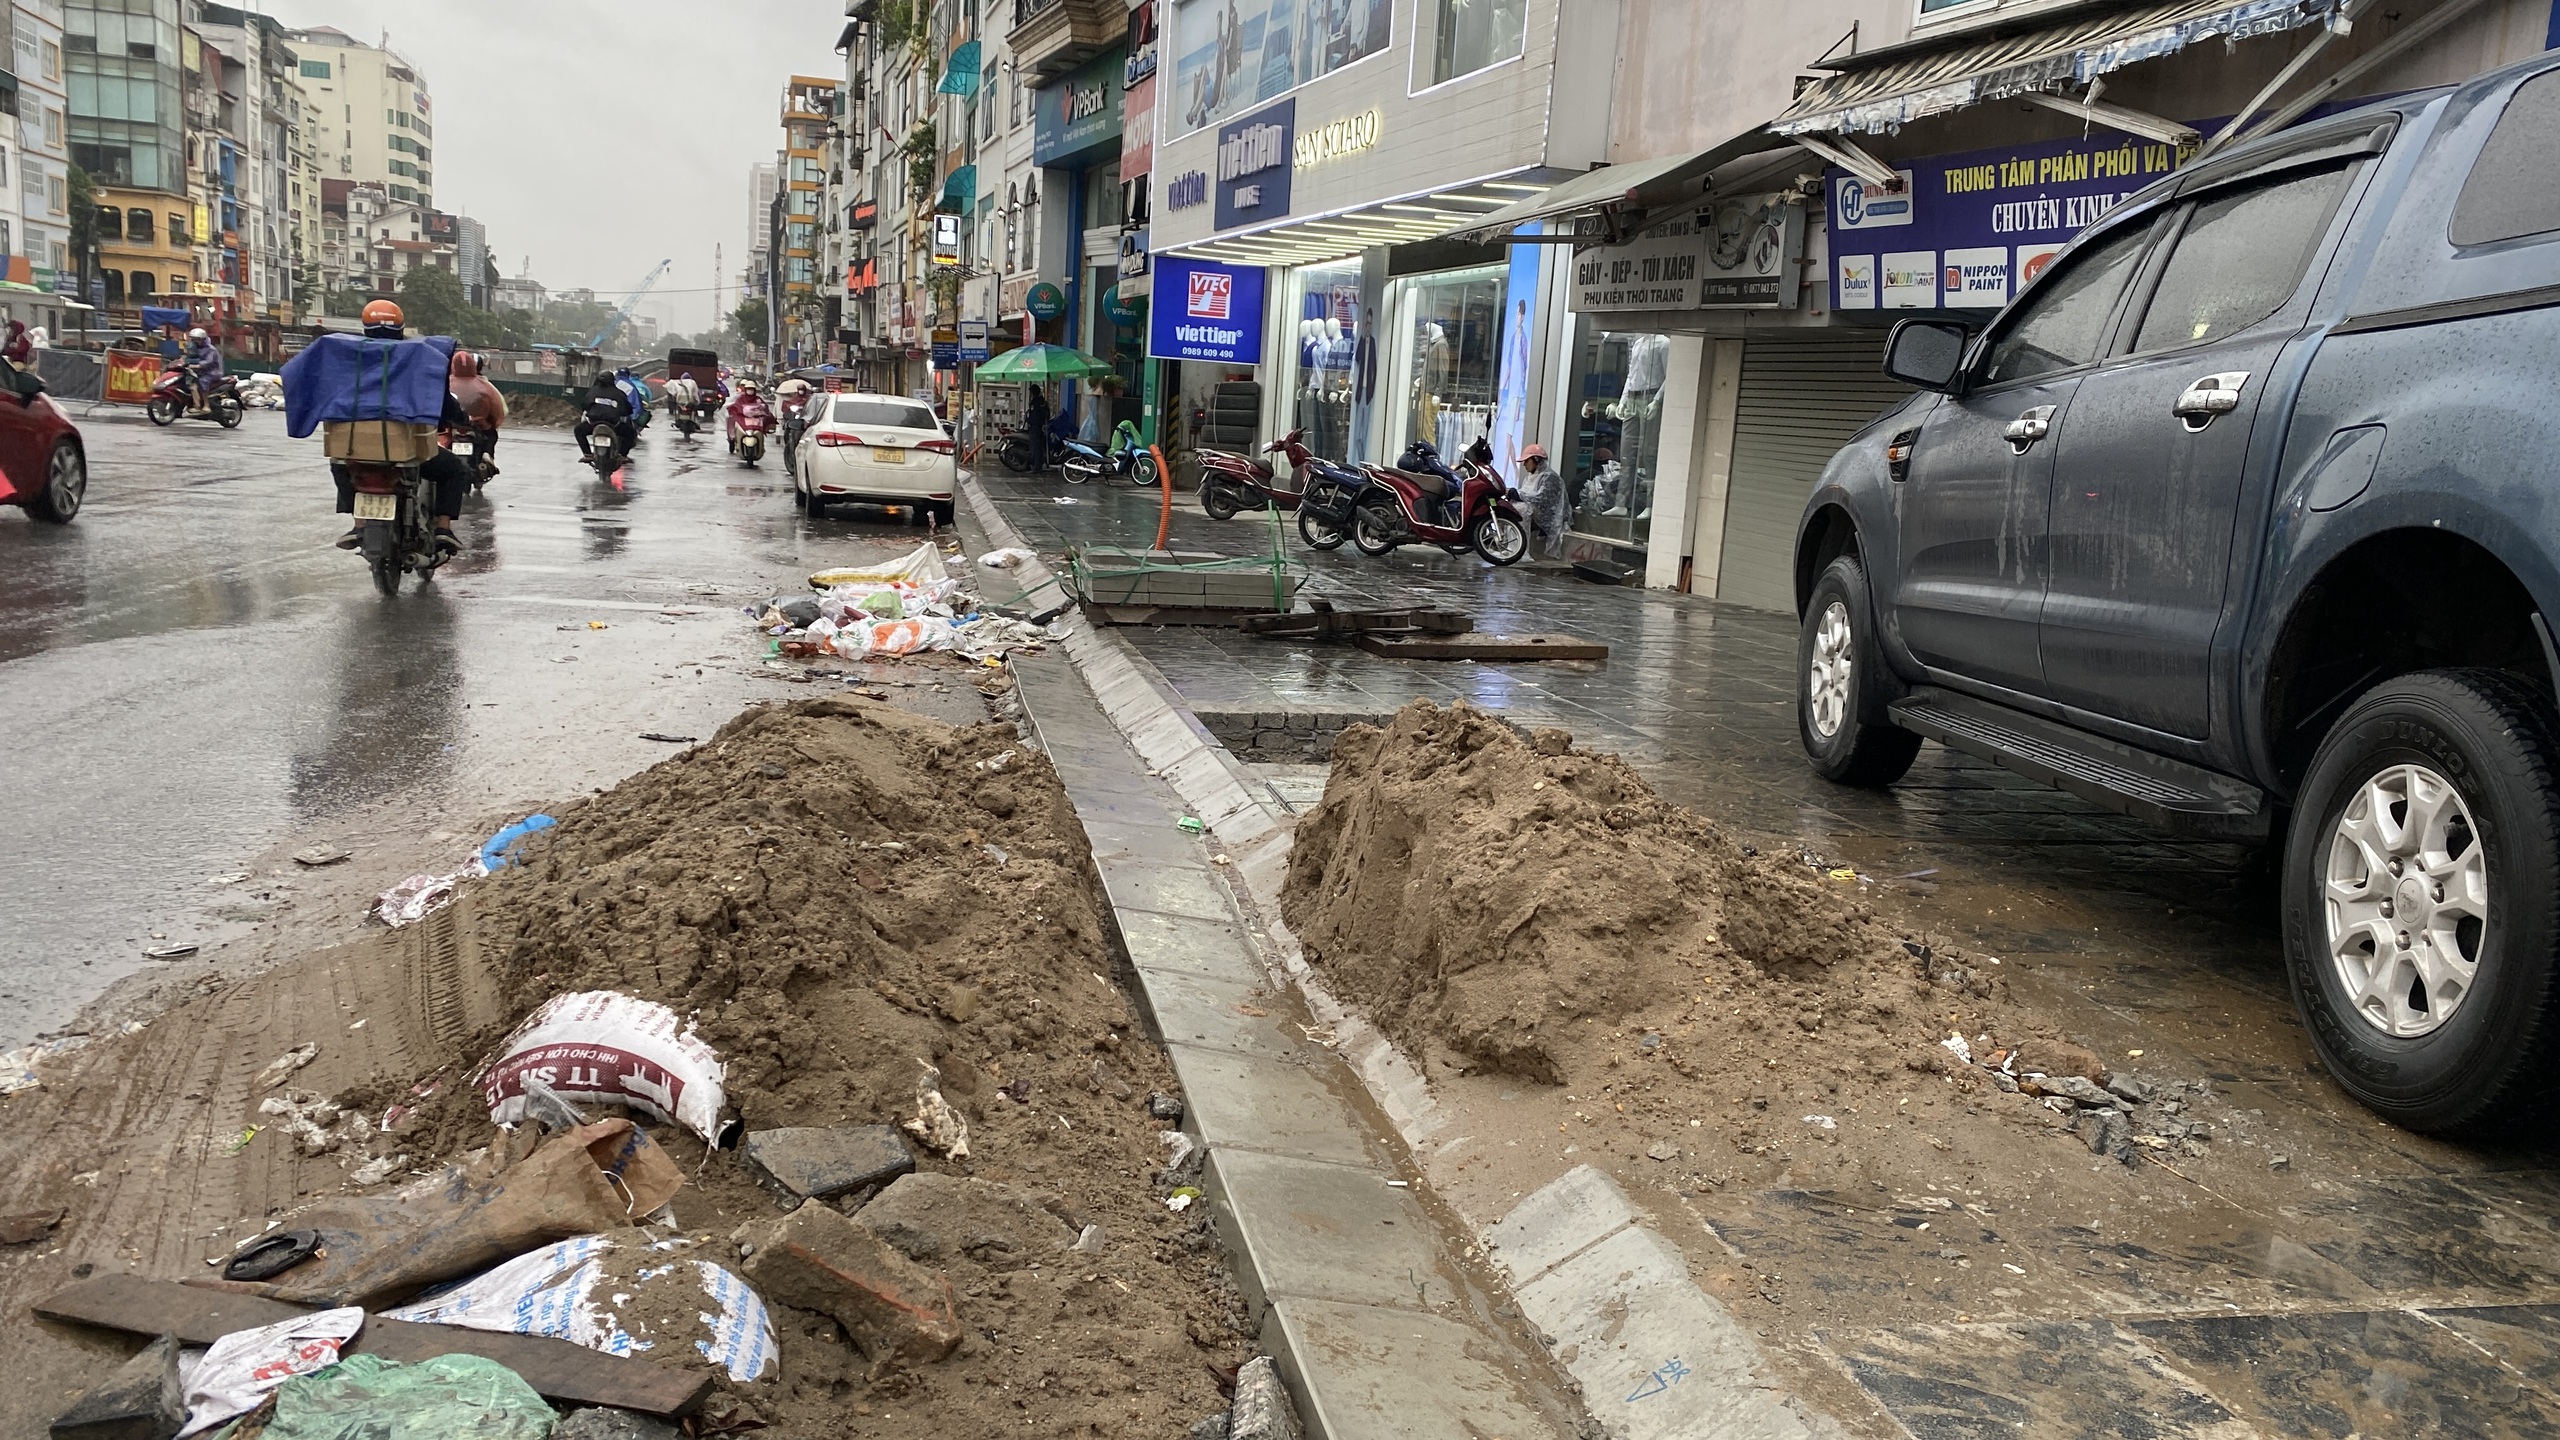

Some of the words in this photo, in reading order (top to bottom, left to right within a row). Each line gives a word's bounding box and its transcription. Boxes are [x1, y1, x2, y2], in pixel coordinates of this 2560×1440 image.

[1073, 81, 1104, 120] VPBank
[1123, 107, 1154, 156] MOTU
[1293, 128, 1323, 169] SAN
[1323, 109, 1380, 159] SCIARO
[1219, 123, 1283, 182] viettien
[1945, 164, 1995, 194] TRUNG
[1999, 156, 2035, 189] TÂM
[2040, 149, 2088, 184] PHÂN
[2094, 138, 2138, 178] PHỐI
[1168, 169, 1207, 212] viettien
[1992, 193, 2060, 233] CHUYÊN
[1642, 254, 1661, 282] TÚI
[1663, 252, 1696, 281] XÁCH
[1963, 264, 2008, 278] NIPPON
[1192, 274, 1230, 294] VTEC
[1844, 277, 1869, 290] Dulux
[1969, 278, 2003, 291] PAINT
[1583, 290, 1601, 305] PHỤ
[1651, 288, 1684, 303] TRANG
[1175, 324, 1237, 345] viettien
[1203, 347, 1218, 358] 609
[1219, 349, 1234, 359] 490
[2379, 720, 2480, 795] DUNLOP
[570, 1049, 594, 1059] CHO
[566, 1066, 601, 1087] TT
